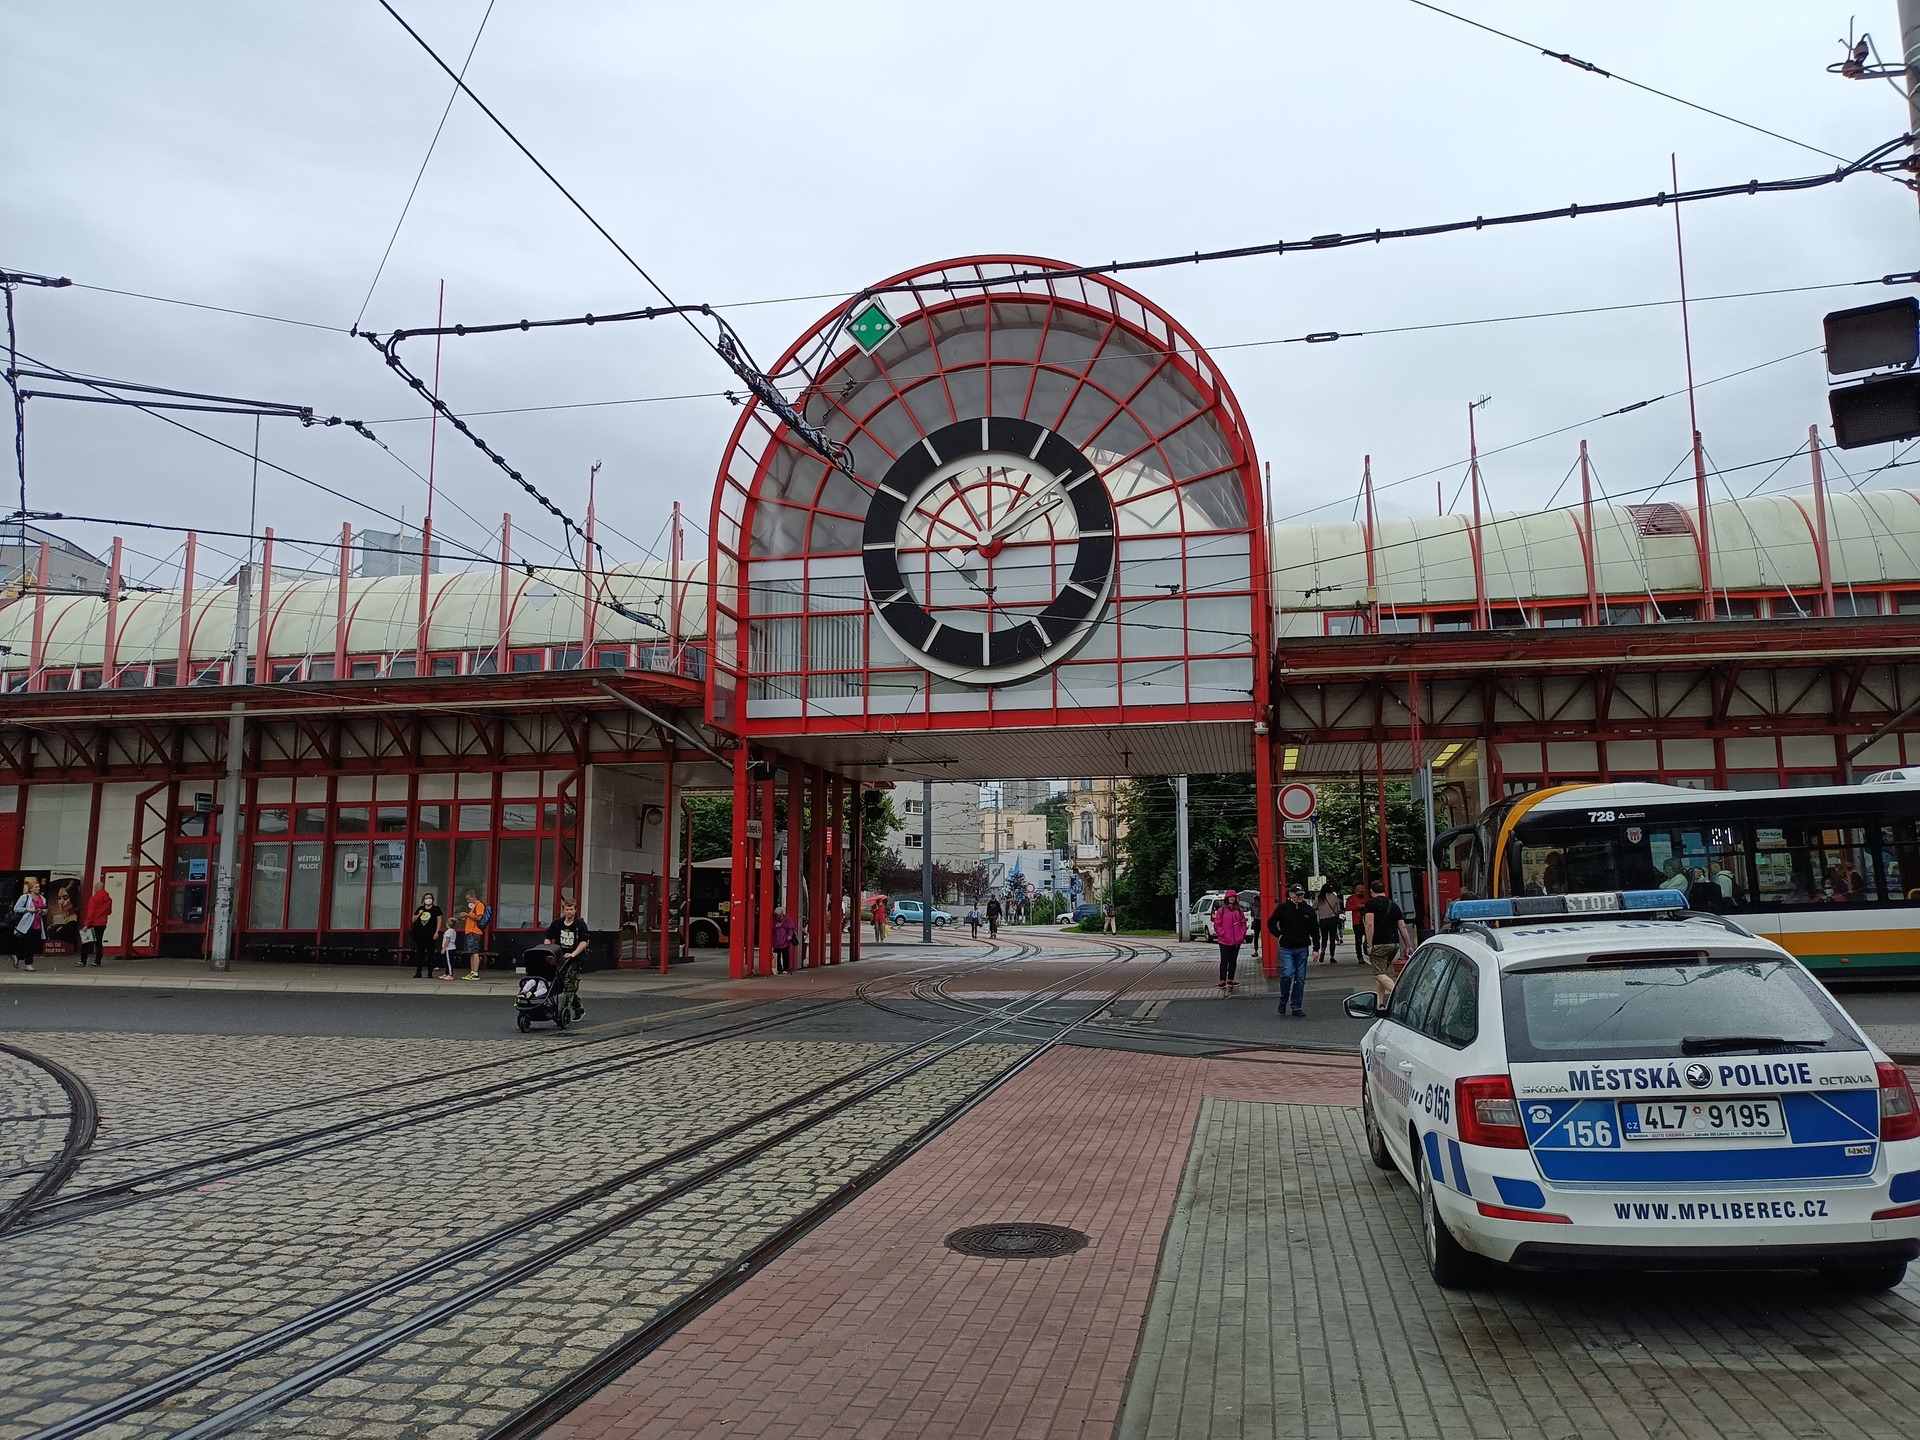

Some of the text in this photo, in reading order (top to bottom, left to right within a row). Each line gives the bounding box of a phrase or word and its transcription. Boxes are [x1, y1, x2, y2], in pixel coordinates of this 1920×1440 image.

[1588, 811, 1615, 823] 728
[1711, 827, 1732, 846] 21
[297, 854, 322, 862] MĚSTSKÁ
[378, 853, 404, 861] MĚSTSKÁ
[380, 861, 401, 869] POLICIE
[1566, 894, 1615, 911] STOP
[1568, 1062, 1813, 1092] MĚSTSKÁ POLICIE
[1818, 1074, 1873, 1085] OCTAVIA
[1434, 1083, 1451, 1125] 156
[1644, 1103, 1771, 1130] 4L7 9195
[1563, 1120, 1613, 1147] 156
[1626, 1121, 1639, 1130] CZ
[1613, 1199, 1829, 1221] WWW.MPLIBEREC.CZ
